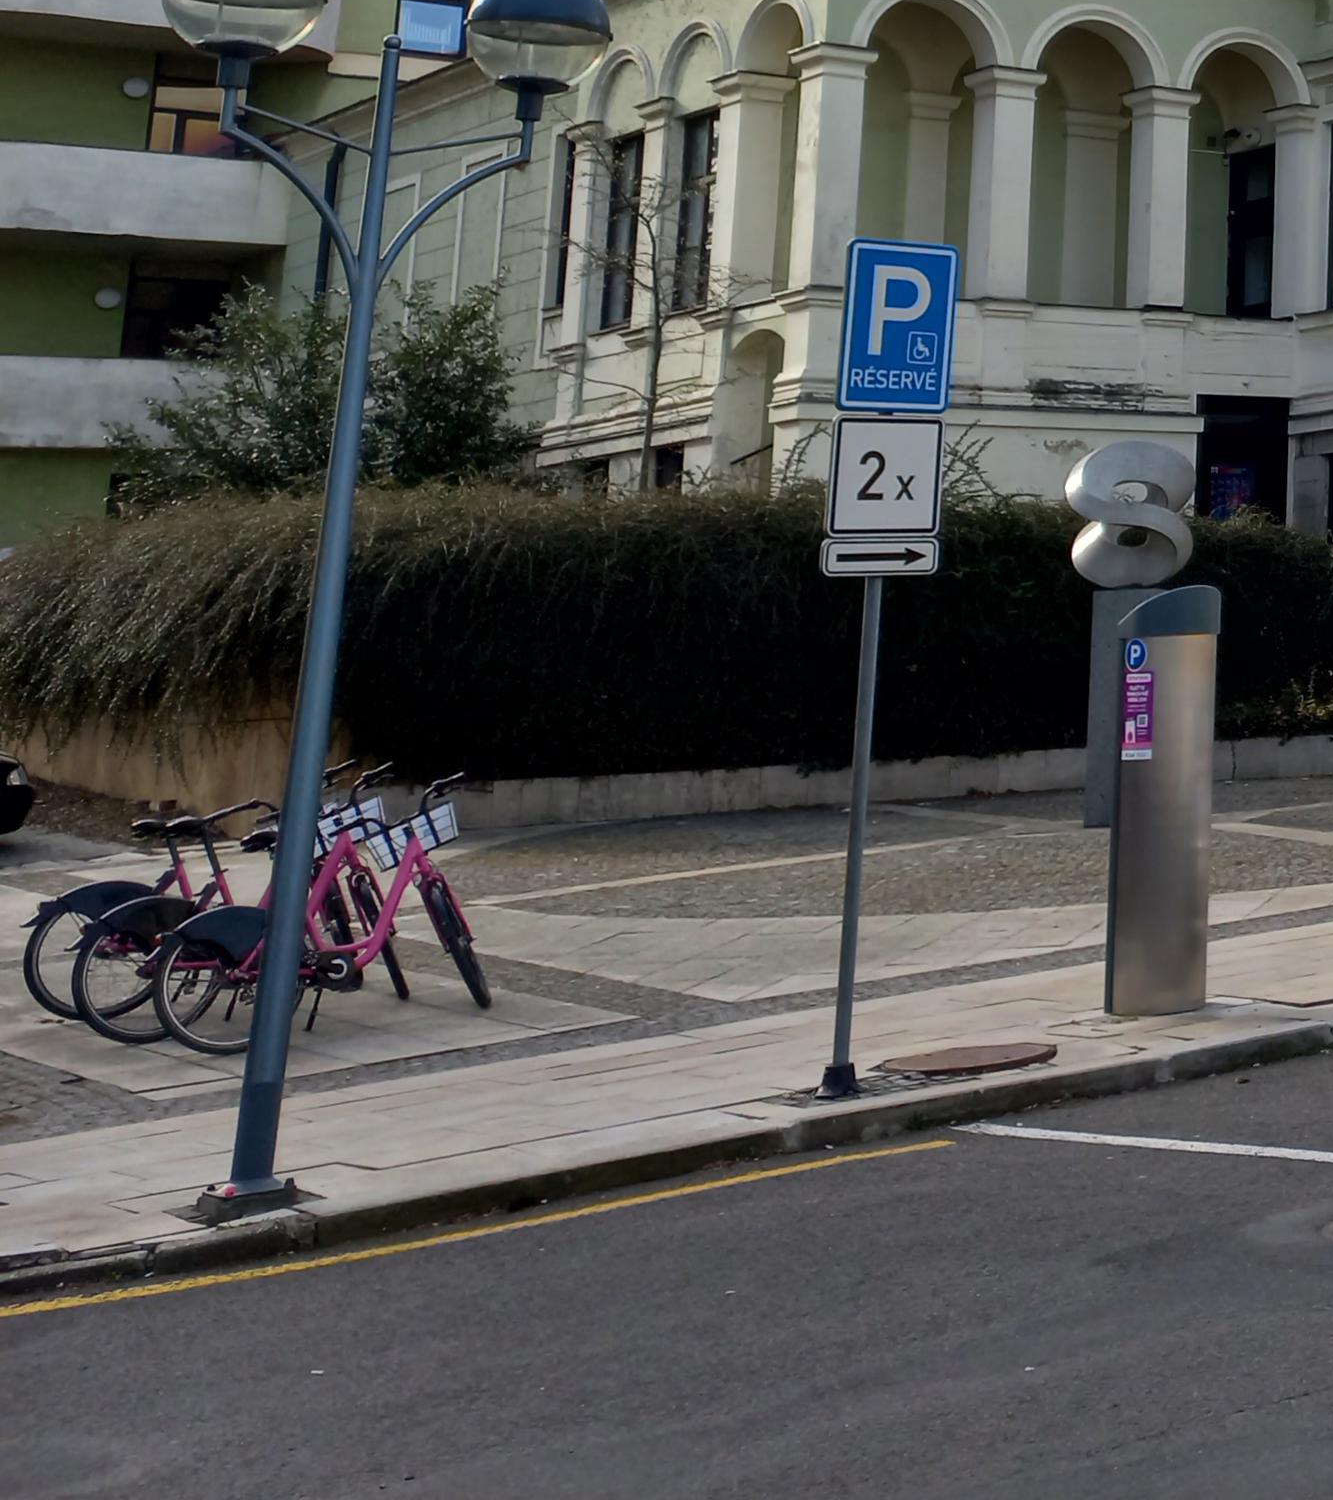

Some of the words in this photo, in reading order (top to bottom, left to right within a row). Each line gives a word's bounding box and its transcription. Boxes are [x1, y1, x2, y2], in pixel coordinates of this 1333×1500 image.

[867, 264, 932, 356] P
[850, 366, 938, 391] RÉSERVÉ
[1130, 645, 1141, 665] P
